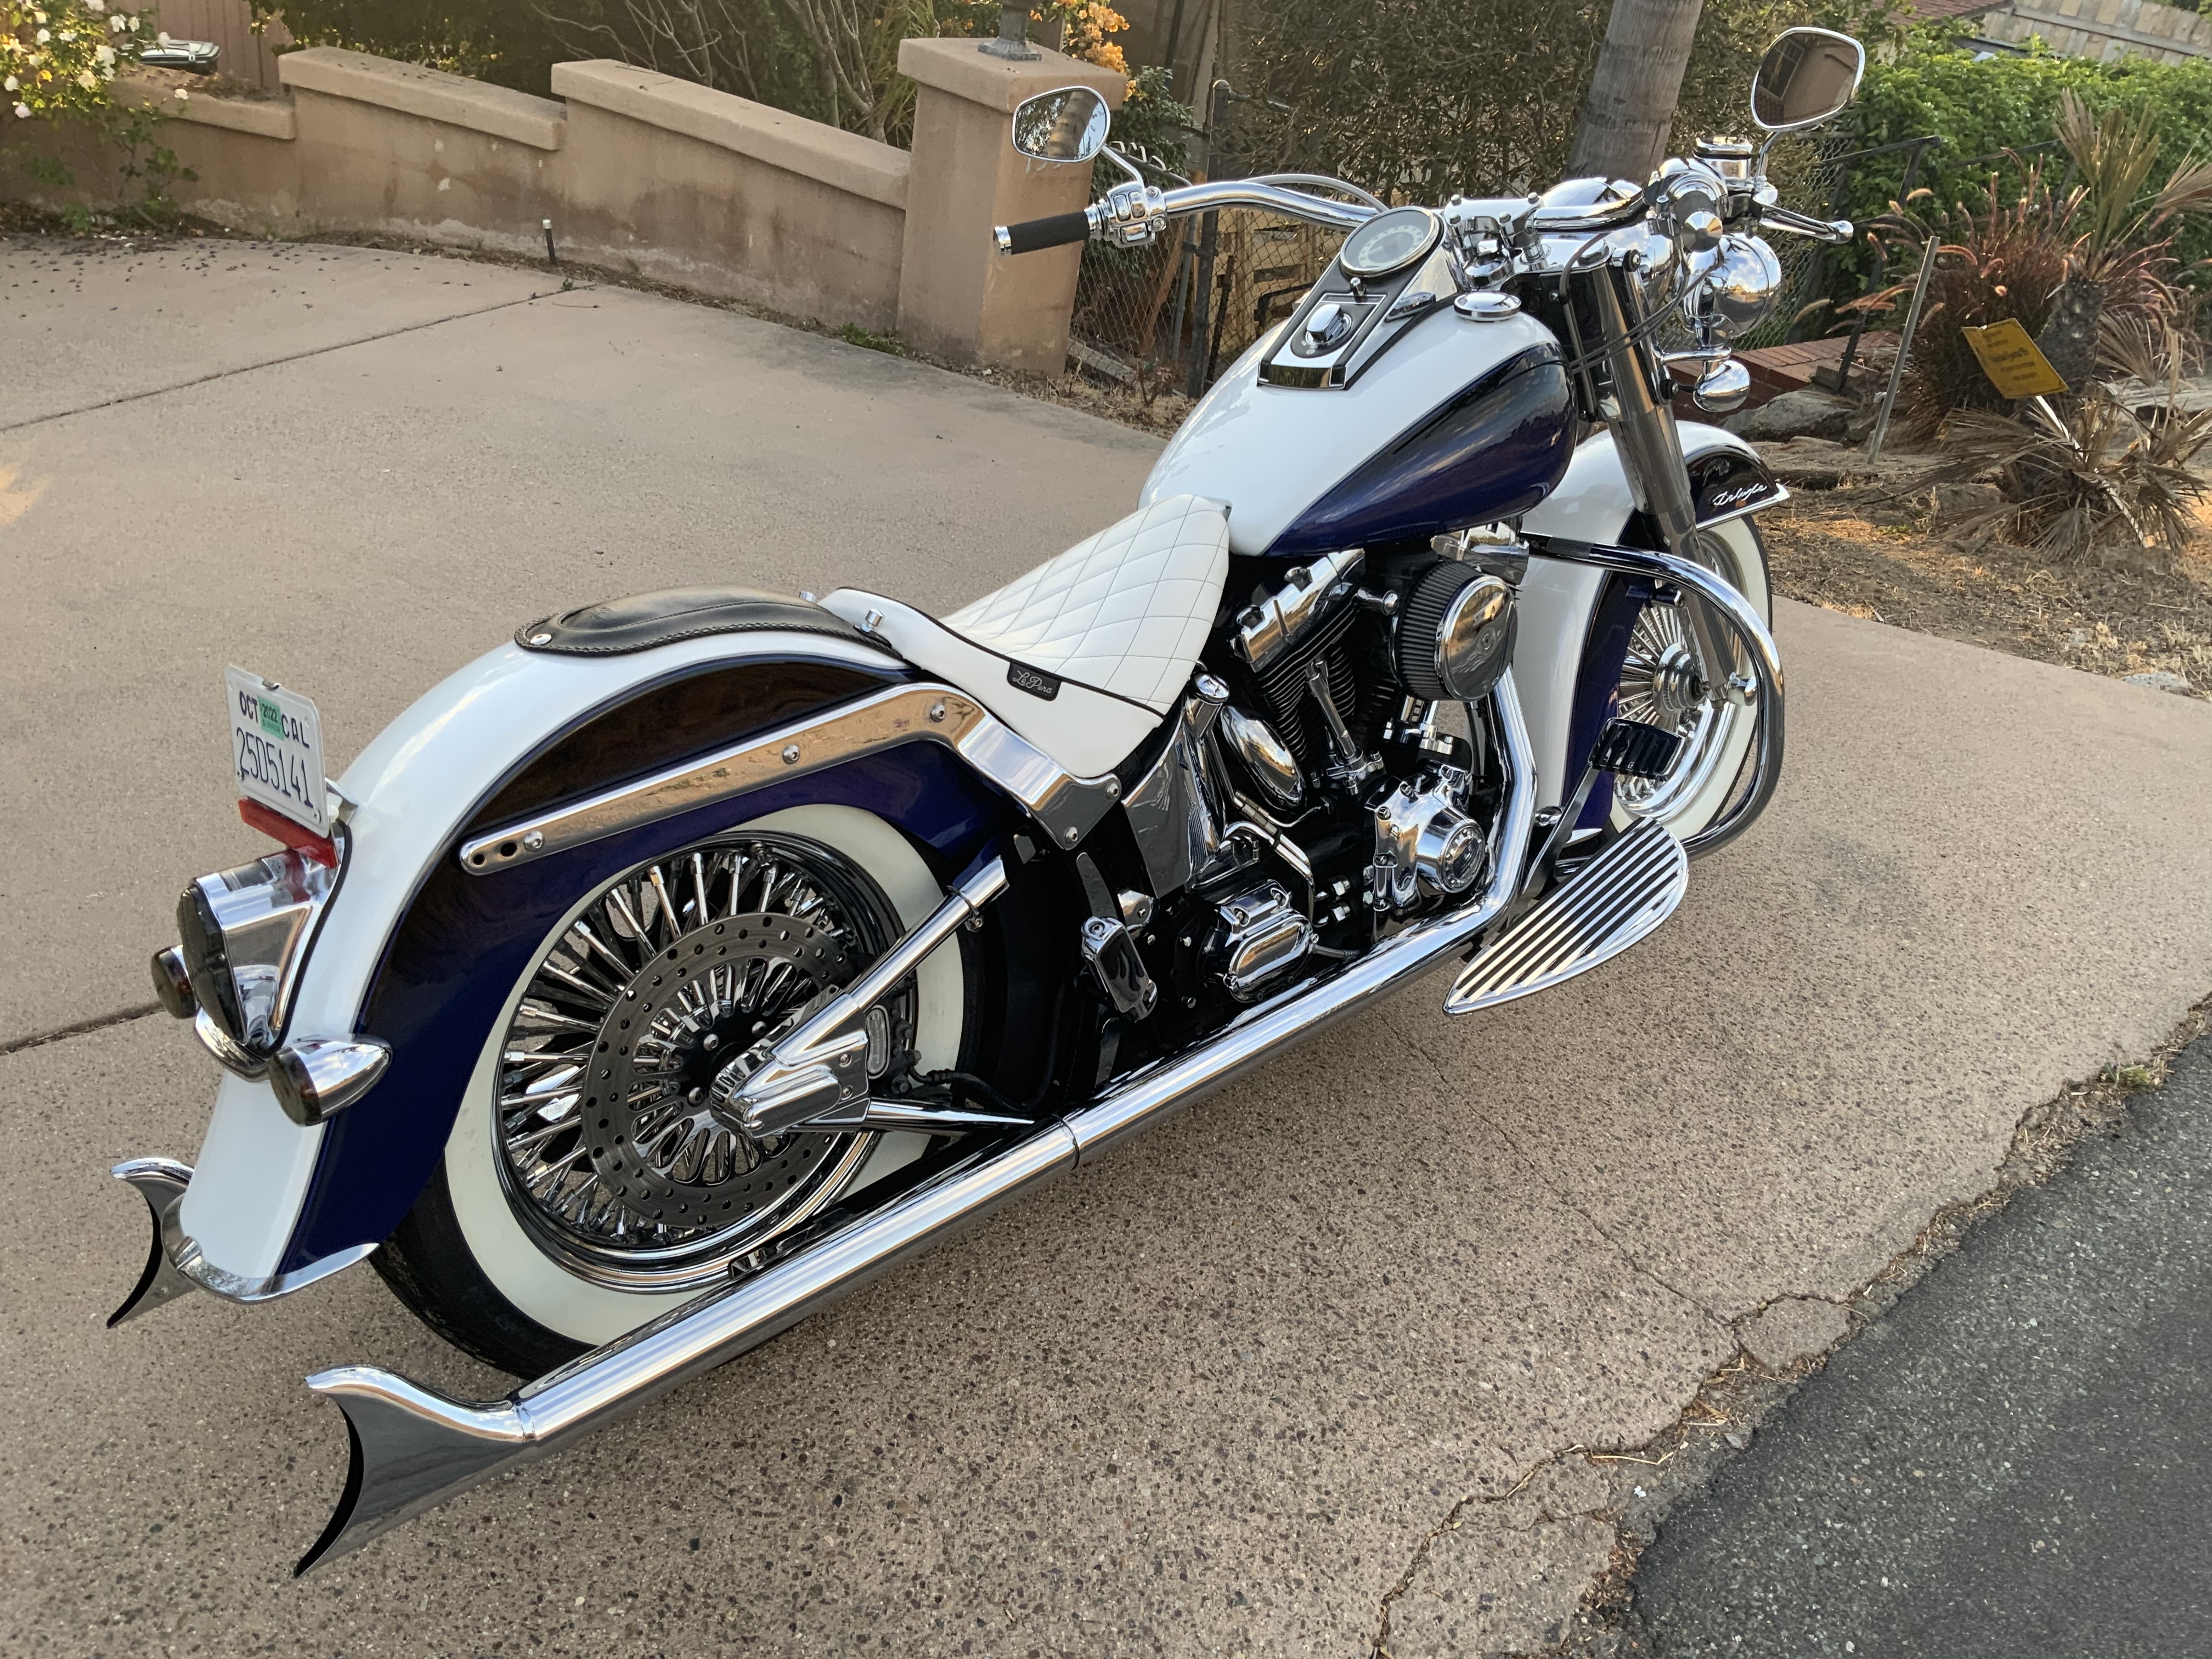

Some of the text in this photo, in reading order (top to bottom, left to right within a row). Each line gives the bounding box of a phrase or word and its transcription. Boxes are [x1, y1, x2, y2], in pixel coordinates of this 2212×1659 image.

[1012, 670, 1053, 693] Le Pera
[239, 690, 258, 724] OCT
[281, 714, 310, 749] CAL
[236, 727, 314, 809] 25D5141
